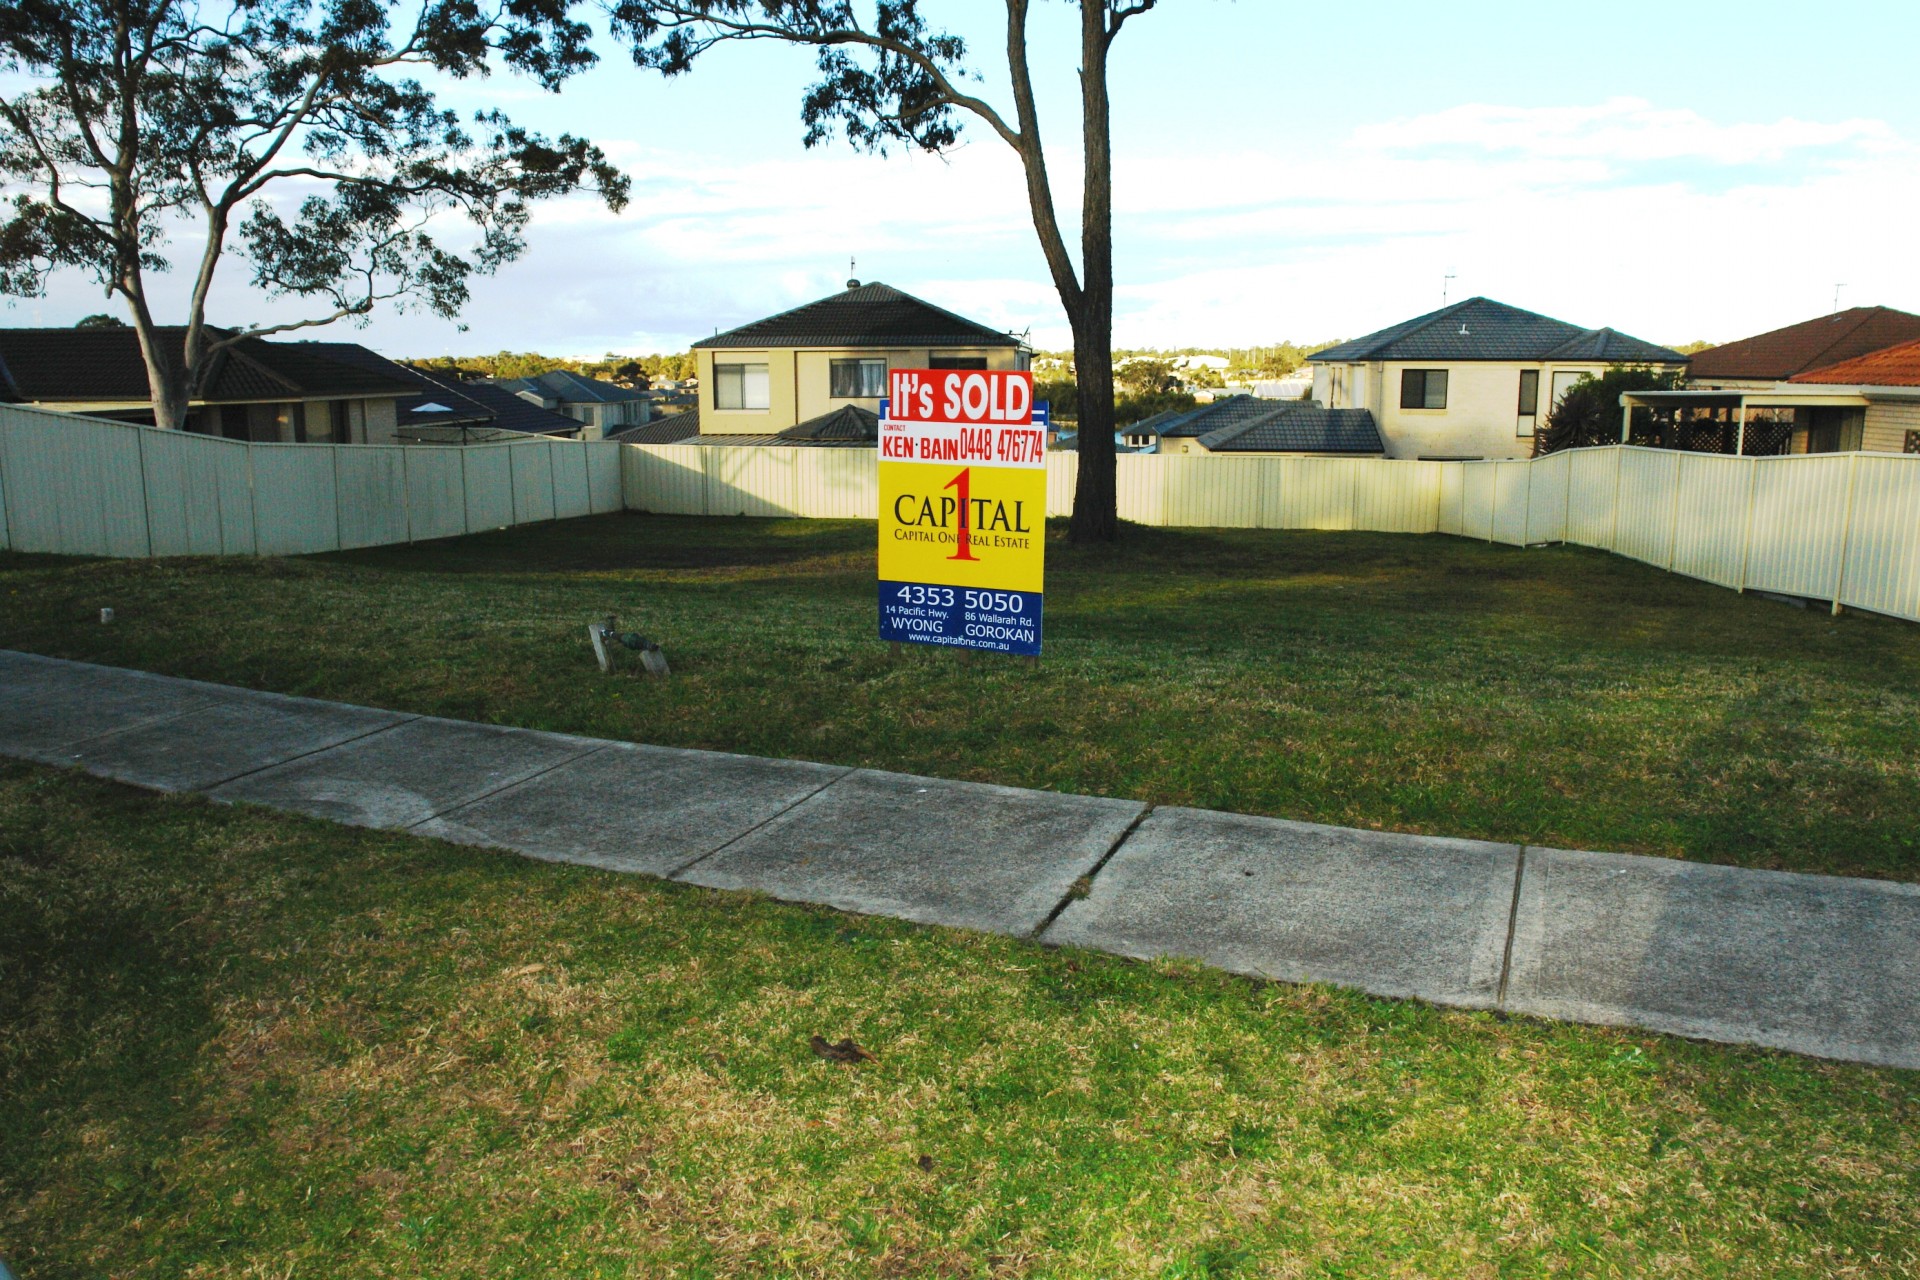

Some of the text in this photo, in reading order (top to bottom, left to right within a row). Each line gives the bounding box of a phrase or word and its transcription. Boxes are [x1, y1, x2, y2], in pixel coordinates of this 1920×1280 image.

[892, 373, 1029, 420] It's SOLD
[883, 428, 1042, 463] KEN BAIN 0448 476774
[894, 495, 1030, 533] CAPITAL
[894, 529, 935, 542] CAPITAL
[995, 536, 1029, 549] ESTATE
[897, 586, 1023, 612] 4353 5050
[899, 607, 925, 616] Pacific
[929, 610, 949, 619] Hwy.
[979, 614, 1016, 625] Wallarah
[1020, 618, 1034, 627] Rd.
[891, 617, 943, 632] WYONG
[965, 624, 1034, 642] GOROKAN
[909, 633, 1009, 650] www.capitalone.com.au
